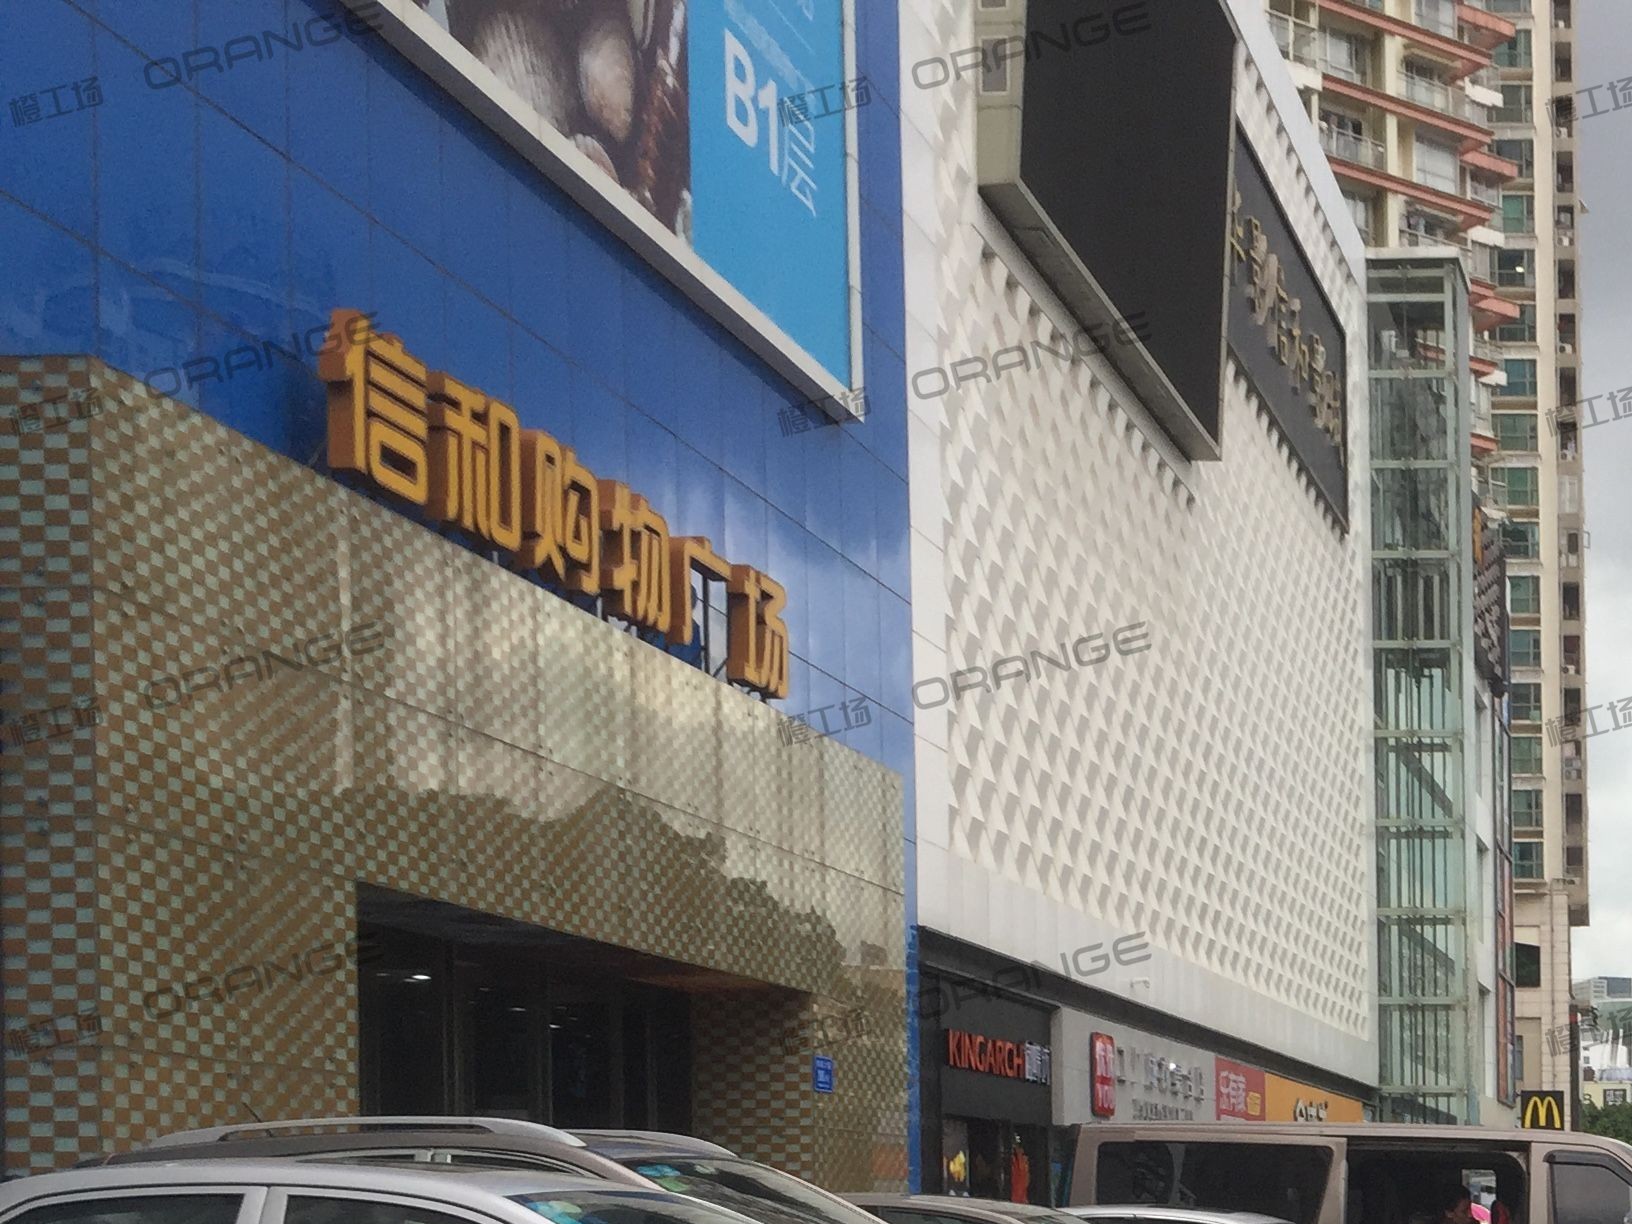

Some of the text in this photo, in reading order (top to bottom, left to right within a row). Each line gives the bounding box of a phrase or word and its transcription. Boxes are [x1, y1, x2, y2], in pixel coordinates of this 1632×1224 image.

[318, 308, 789, 699] 信和购物广场
[947, 1029, 1025, 1079] KINGARCH
